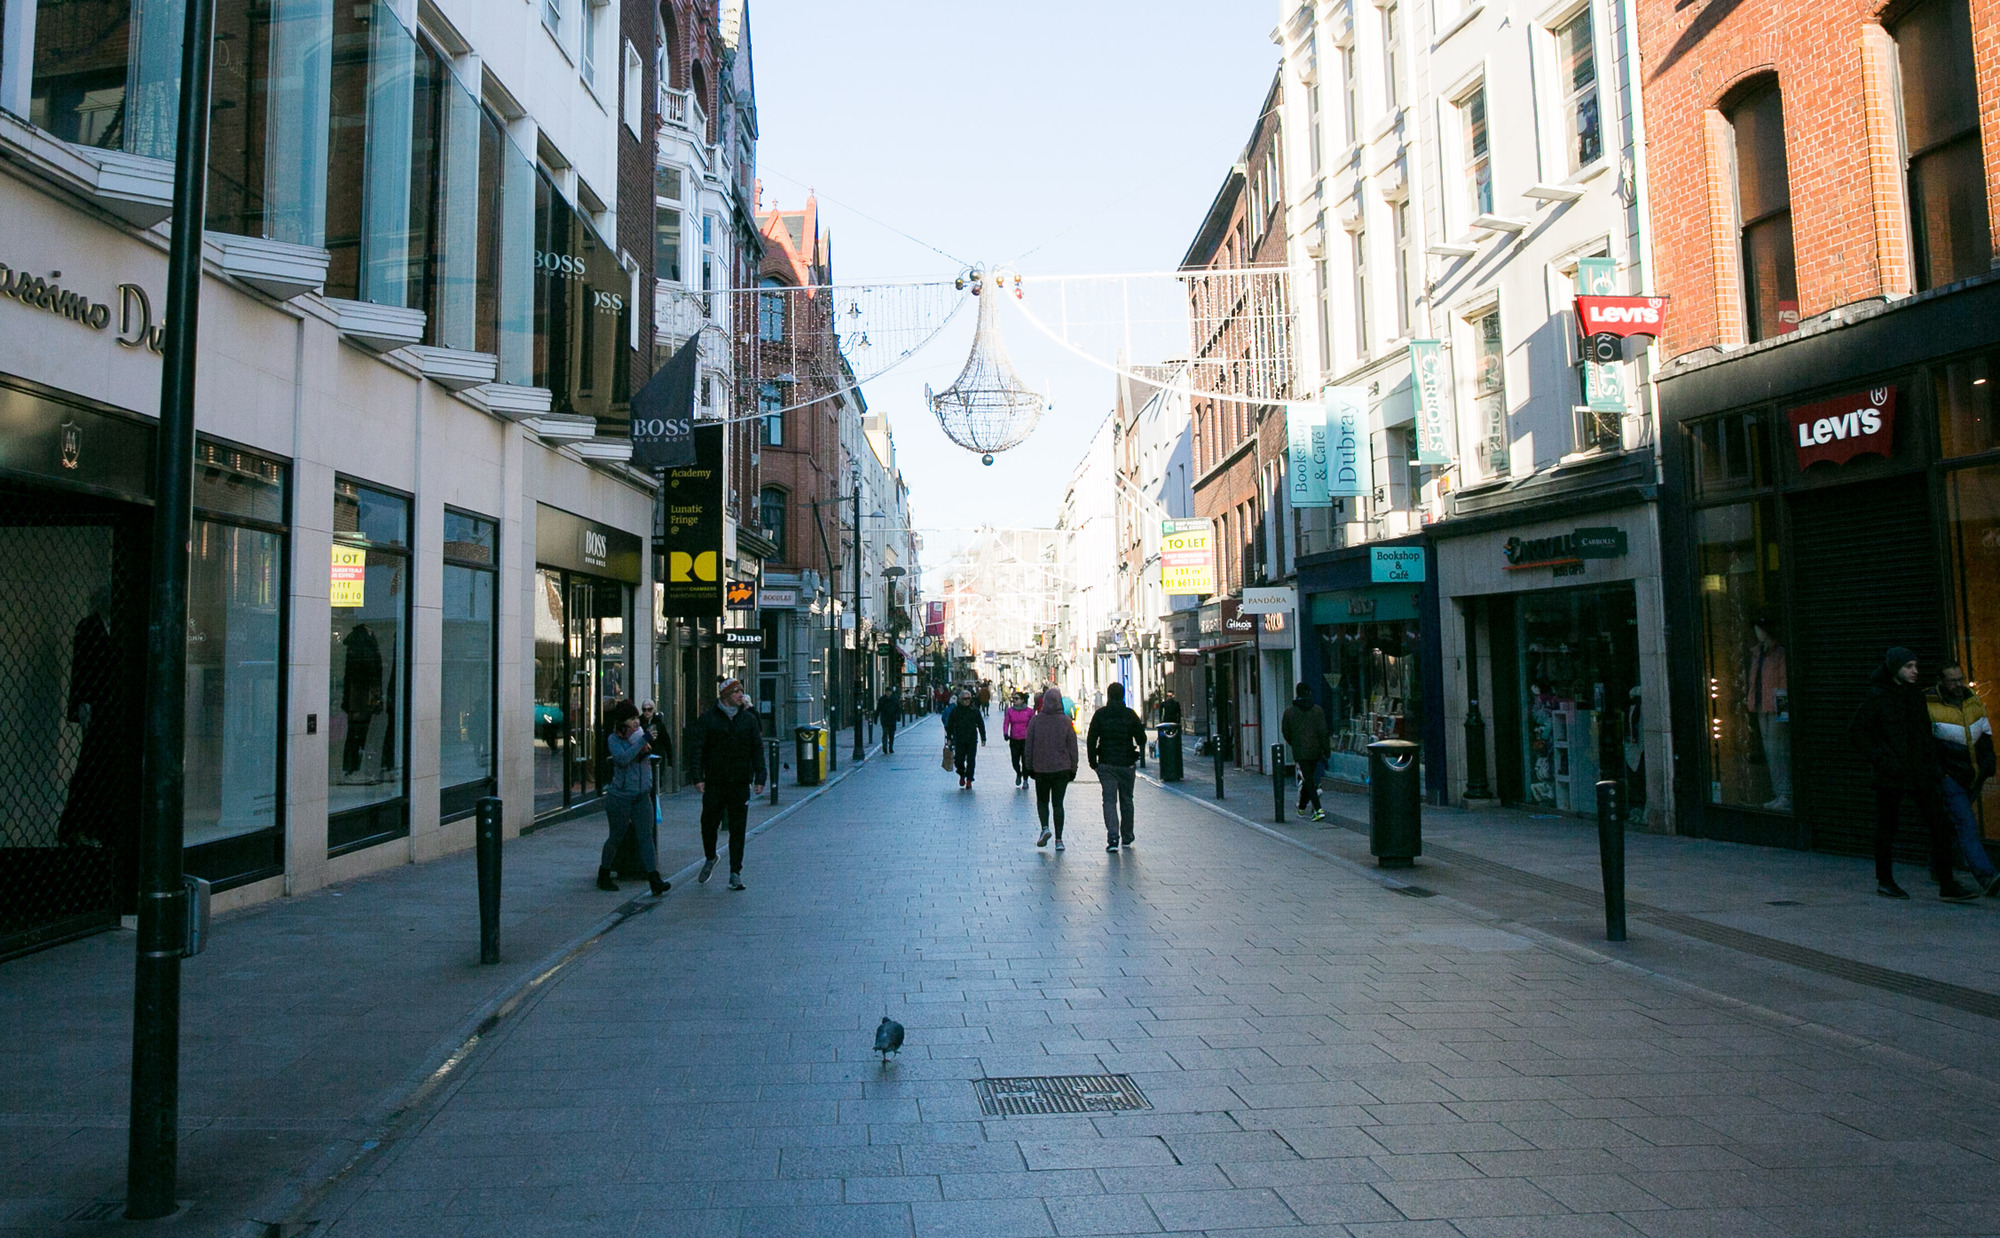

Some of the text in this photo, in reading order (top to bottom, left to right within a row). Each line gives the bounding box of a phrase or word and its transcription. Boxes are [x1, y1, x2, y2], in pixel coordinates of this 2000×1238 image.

[535, 250, 586, 275] BOSS
[116, 283, 166, 355] Du
[633, 418, 690, 436] BOSS
[1336, 401, 1359, 484] Dubray
[1293, 419, 1308, 493] Bookshop
[1312, 431, 1328, 480] & Café
[671, 468, 711, 479] Academy
[671, 479, 680, 488] @
[671, 504, 703, 513] Lunatic
[670, 515, 698, 526] Fringe
[671, 525, 680, 534] @
[585, 530, 607, 558] BOSS
[1168, 537, 1206, 549] TO LET
[1376, 550, 1420, 562] Bookshop
[1175, 567, 1189, 575] 111
[1395, 561, 1402, 570] &
[1389, 570, 1409, 580] Café
[1165, 578, 1211, 588] 01 6611233
[726, 633, 762, 642] Dune
